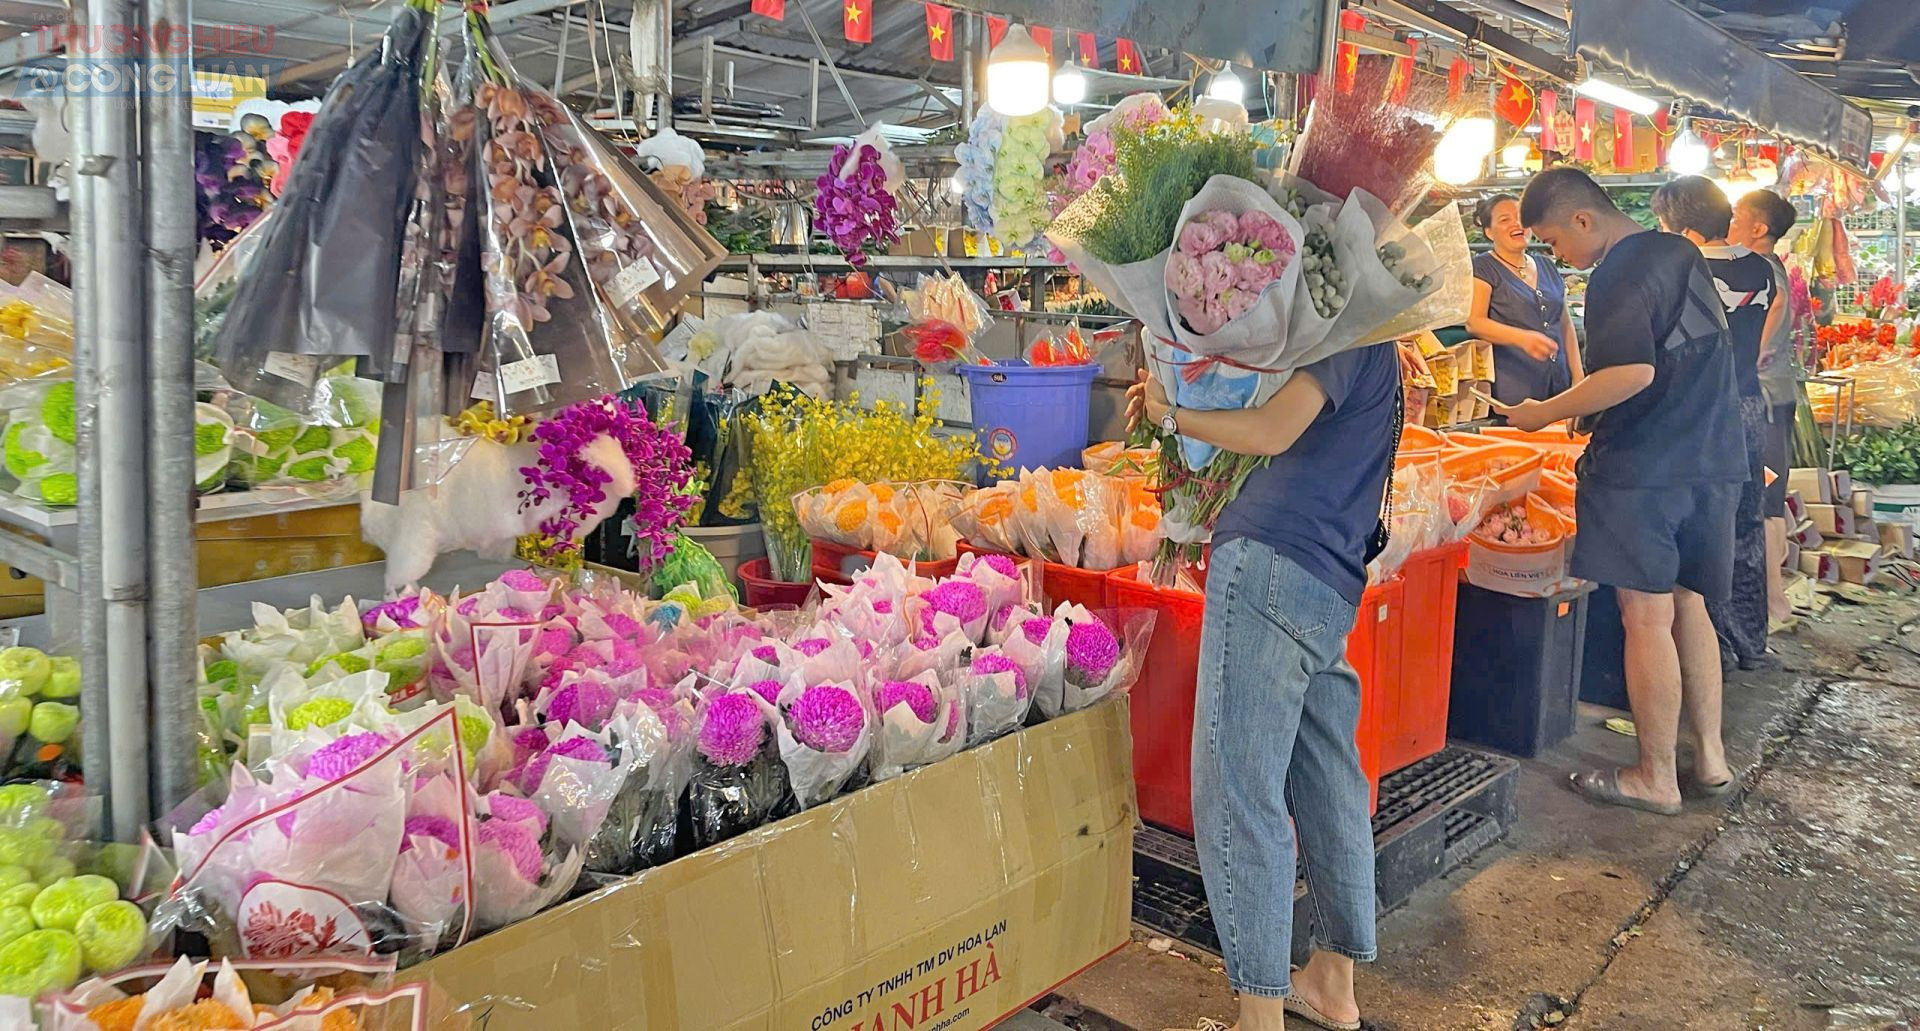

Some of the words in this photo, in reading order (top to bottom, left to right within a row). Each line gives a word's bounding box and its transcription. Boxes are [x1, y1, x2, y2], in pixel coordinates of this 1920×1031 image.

[811, 999, 853, 1031] CÔNG
[857, 987, 875, 1008] TY
[877, 967, 914, 997] TNHH
[916, 956, 935, 977] TM
[938, 945, 955, 967] DV
[957, 933, 982, 956] HOA
[985, 919, 1007, 942] LAN
[954, 941, 1002, 1005] HÀ
